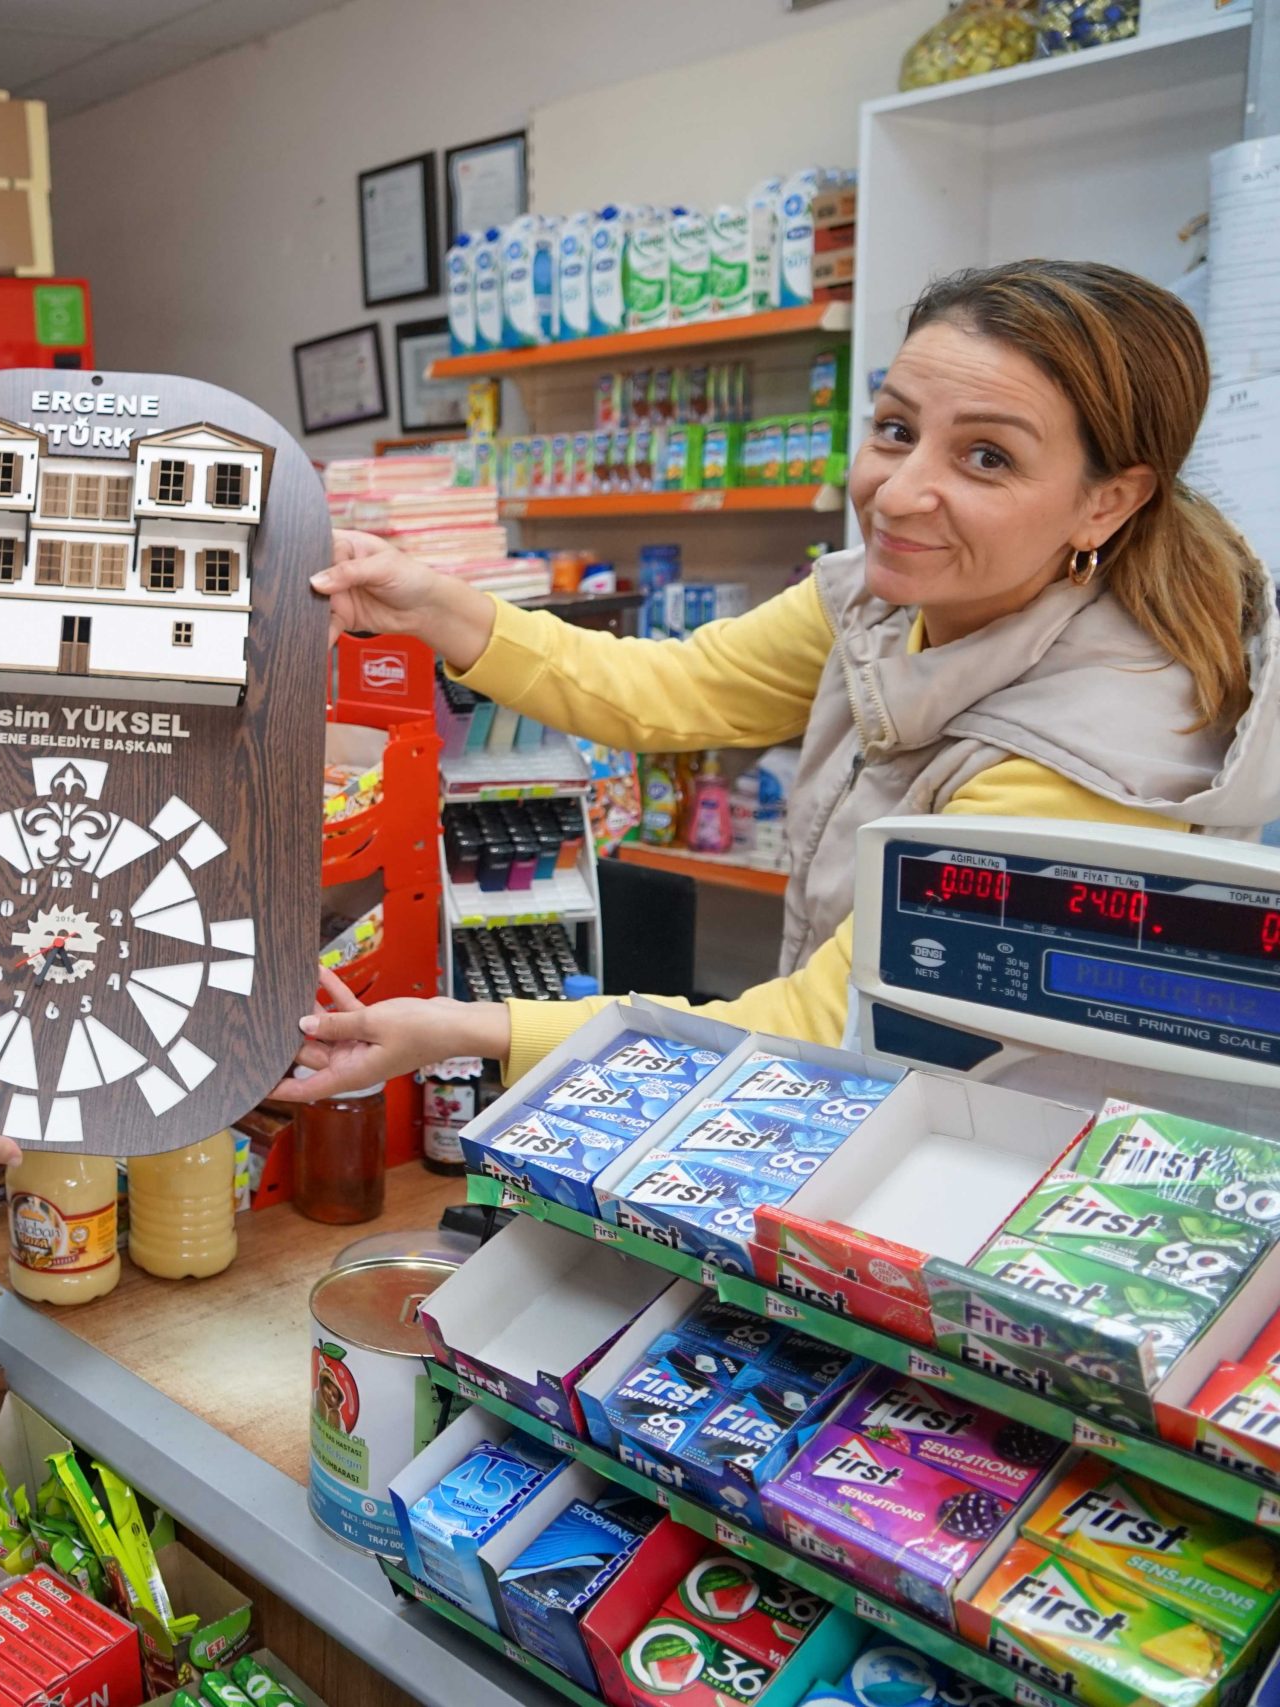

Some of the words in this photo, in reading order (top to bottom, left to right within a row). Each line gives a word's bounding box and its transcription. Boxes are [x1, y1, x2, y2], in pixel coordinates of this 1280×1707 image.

[31, 390, 160, 417] ERGENE
[62, 705, 191, 738] YÜKSEL
[31, 733, 100, 750] BELEDİYE
[104, 739, 172, 754] BAŞKANI
[21, 878, 37, 895] 11
[52, 871, 72, 888] 12
[1054, 867, 1078, 879] BİRİM
[1083, 869, 1109, 883] FİYAT
[92, 882, 99, 899] 1
[1229, 891, 1270, 905] TOPLAM
[110, 909, 123, 926] 2
[119, 941, 130, 959] 3
[977, 952, 995, 962] Max
[1006, 957, 1017, 966] 30
[1018, 959, 1029, 969] kg
[107, 973, 120, 991] 4
[915, 967, 940, 979] NETS
[977, 962, 992, 972] Min
[1004, 968, 1021, 978] 200
[1011, 979, 1020, 988] 10
[14, 990, 25, 1008] 7
[45, 1001, 59, 1019] 6
[80, 995, 92, 1013] 5
[1087, 1008, 1131, 1025] LABEL
[1138, 1018, 1210, 1041] PRINTING
[1218, 1034, 1271, 1052] SCALE
[605, 1046, 687, 1074] First
[550, 1077, 633, 1106] First
[740, 1070, 828, 1098] First
[585, 1109, 651, 1128] SENSATION
[821, 1099, 874, 1121] 60
[492, 1124, 575, 1155] First
[687, 1118, 780, 1150] First
[769, 1150, 822, 1174] 60
[1099, 1134, 1214, 1181] First
[481, 1162, 533, 1194] First
[528, 1159, 592, 1184] SENSATION
[503, 1188, 527, 1204] First
[632, 1171, 723, 1204] First
[1215, 1180, 1280, 1220] 60
[616, 1211, 683, 1249] First
[1039, 1195, 1163, 1238] First
[593, 1223, 618, 1240] First
[1156, 1241, 1229, 1275] 60
[777, 1273, 850, 1314] First
[992, 1262, 1108, 1309] First
[765, 1296, 799, 1317] First
[732, 1325, 770, 1344] 60
[963, 1302, 1048, 1348] First
[908, 1354, 949, 1378] First
[961, 1344, 1052, 1395] First
[455, 1362, 508, 1400] First
[626, 1367, 713, 1406] First
[618, 1388, 689, 1412] INFINITY
[867, 1388, 975, 1436] First
[640, 1423, 678, 1443] DAKİKA
[647, 1412, 686, 1434] 60
[709, 1403, 787, 1443] Firs
[1073, 1423, 1119, 1448] First
[619, 1444, 686, 1487] First
[818, 1446, 904, 1487] First
[919, 1439, 1029, 1481] SENSATIONS
[1195, 1440, 1280, 1485] Firs
[837, 1485, 926, 1522] SENSATIONS
[570, 1504, 635, 1543] STORMING
[715, 1523, 749, 1545] First
[1062, 1490, 1190, 1553] First
[368, 1534, 388, 1547] TR47
[783, 1520, 848, 1565] First
[38, 1578, 71, 1603] ÜLKER
[1127, 1555, 1257, 1612] SENSATIONS
[18, 1592, 51, 1617] ÜLKER
[762, 1582, 817, 1622] 36
[854, 1596, 892, 1621] First
[1000, 1573, 1129, 1643] First
[706, 1648, 765, 1696] 36
[988, 1636, 1078, 1697] First
